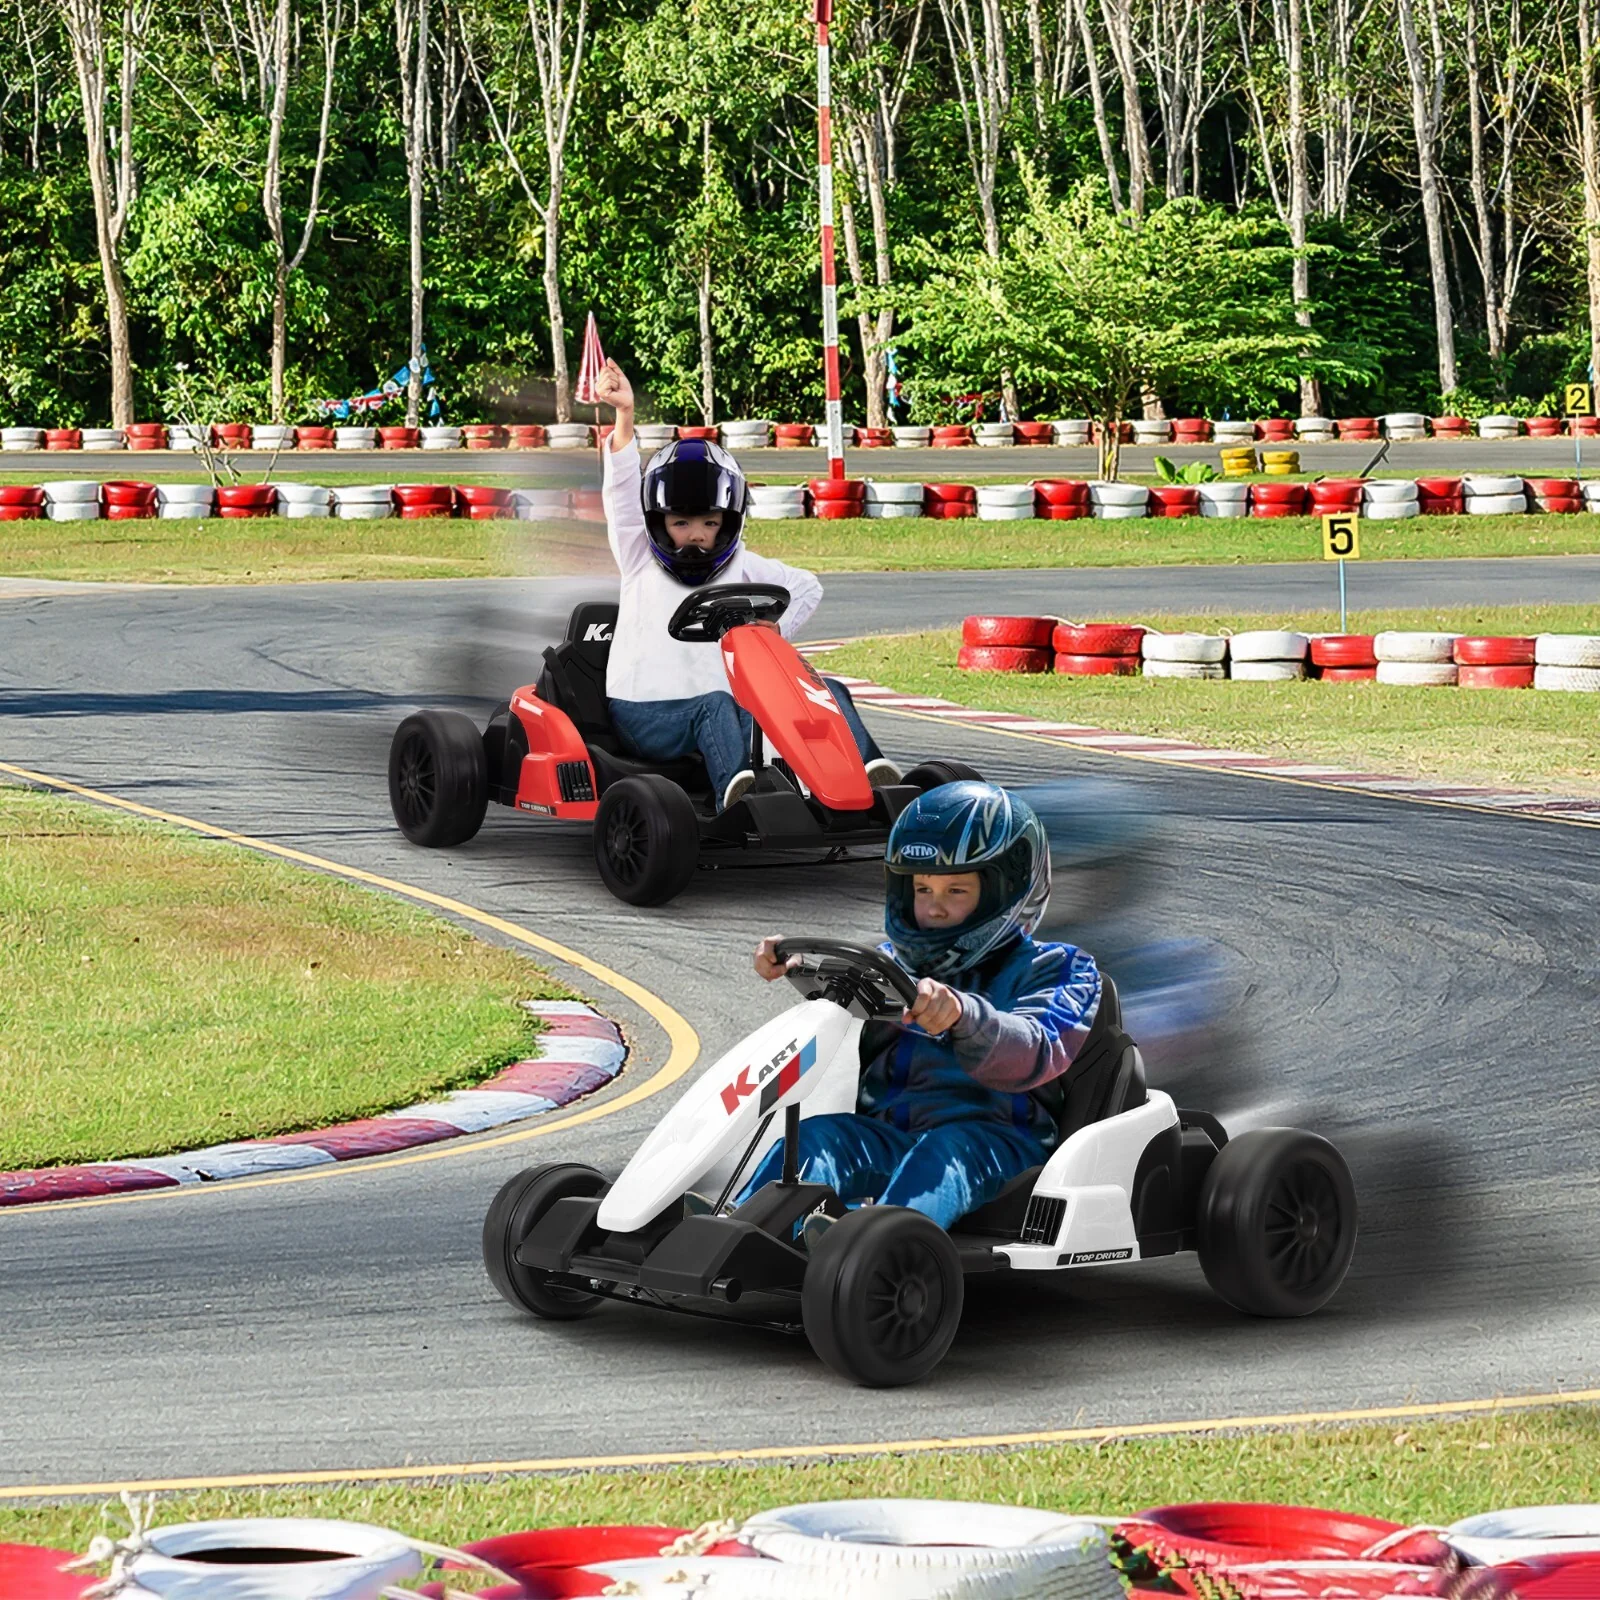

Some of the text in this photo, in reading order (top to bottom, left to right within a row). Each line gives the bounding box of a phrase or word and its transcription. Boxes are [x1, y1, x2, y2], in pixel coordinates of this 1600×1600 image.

[1570, 387, 1586, 410] 2
[1329, 518, 1354, 555] 5
[582, 623, 613, 641] KA
[720, 1038, 797, 1116] KART
[1075, 1250, 1129, 1263] TOP DRIVER
